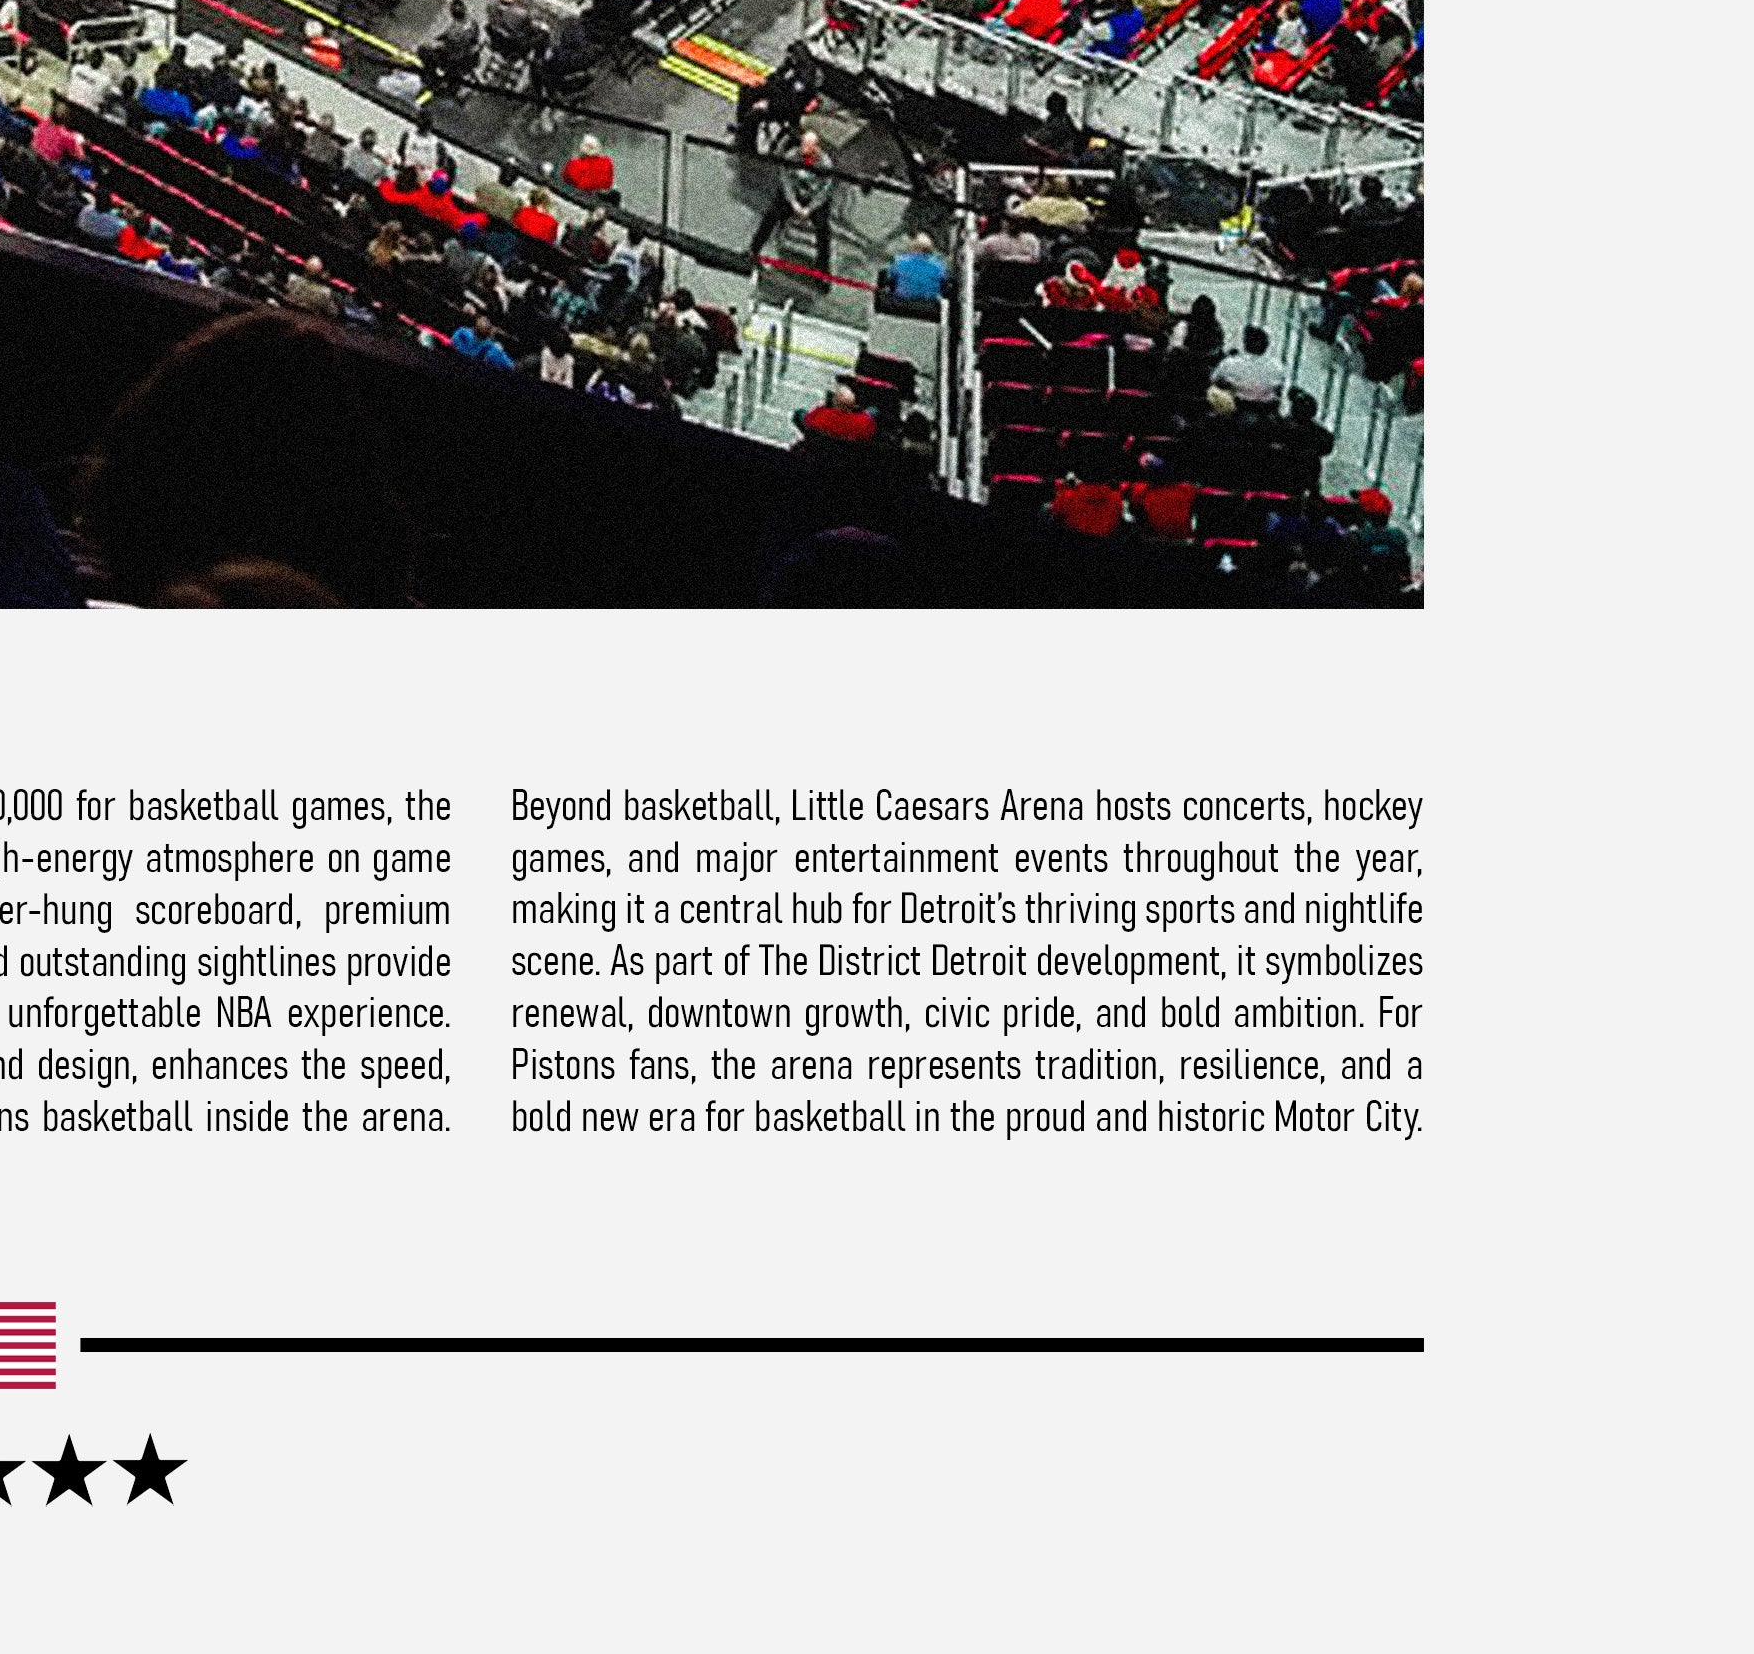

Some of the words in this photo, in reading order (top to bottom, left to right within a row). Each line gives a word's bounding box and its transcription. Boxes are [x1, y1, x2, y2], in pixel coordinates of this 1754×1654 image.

[77, 789, 115, 820] for
[130, 789, 278, 820] basketball
[293, 798, 392, 829] games,
[405, 789, 450, 820] the
[513, 789, 610, 829] Beyond
[625, 789, 779, 826] basketball,
[793, 789, 863, 820] Little
[877, 789, 989, 820] Caesars
[1001, 789, 1082, 820] Arena
[1097, 789, 1171, 820] hosts
[1184, 792, 1312, 825] concerts,
[1325, 789, 1423, 829] hockey
[513, 850, 611, 881] games,
[629, 841, 678, 872] and
[697, 842, 777, 881] major
[796, 842, 998, 872] entertainment
[1016, 844, 1108, 872] events
[1123, 841, 1278, 881] throughout
[1294, 841, 1339, 872] the
[1356, 850, 1422, 881] year,
[136, 893, 301, 930] scoreboard,
[326, 894, 449, 933] premium
[21, 945, 185, 985] outstanding
[198, 945, 336, 985] sightlines
[348, 945, 450, 985] provide
[9, 996, 200, 1036] unforgettable
[218, 996, 271, 1027] NBA
[289, 997, 450, 1036] experience.
[513, 996, 633, 1033] renewal,
[649, 996, 790, 1027] downtown
[806, 996, 910, 1036] growth,
[926, 997, 989, 1027] civic
[1004, 996, 1081, 1036] pride,
[1097, 996, 1145, 1027] and
[1162, 996, 1219, 1027] bold
[1235, 996, 1364, 1027] ambition.
[1380, 996, 1422, 1027] For
[44, 1100, 192, 1131] basketball
[208, 1100, 288, 1131] inside
[302, 1100, 347, 1131] the
[363, 1109, 450, 1131] arena.
[513, 1100, 570, 1131] bold
[583, 1109, 639, 1131] new
[650, 1109, 694, 1131] era
[706, 1100, 744, 1131] for
[756, 1100, 905, 1131] basketball
[917, 1101, 939, 1131] in
[950, 1100, 994, 1131] the
[1007, 1100, 1084, 1140] proud
[1097, 1100, 1146, 1131] and
[1159, 1100, 1264, 1131] historic
[1276, 1100, 1354, 1131] Motor
[1367, 1100, 1422, 1140] City.
